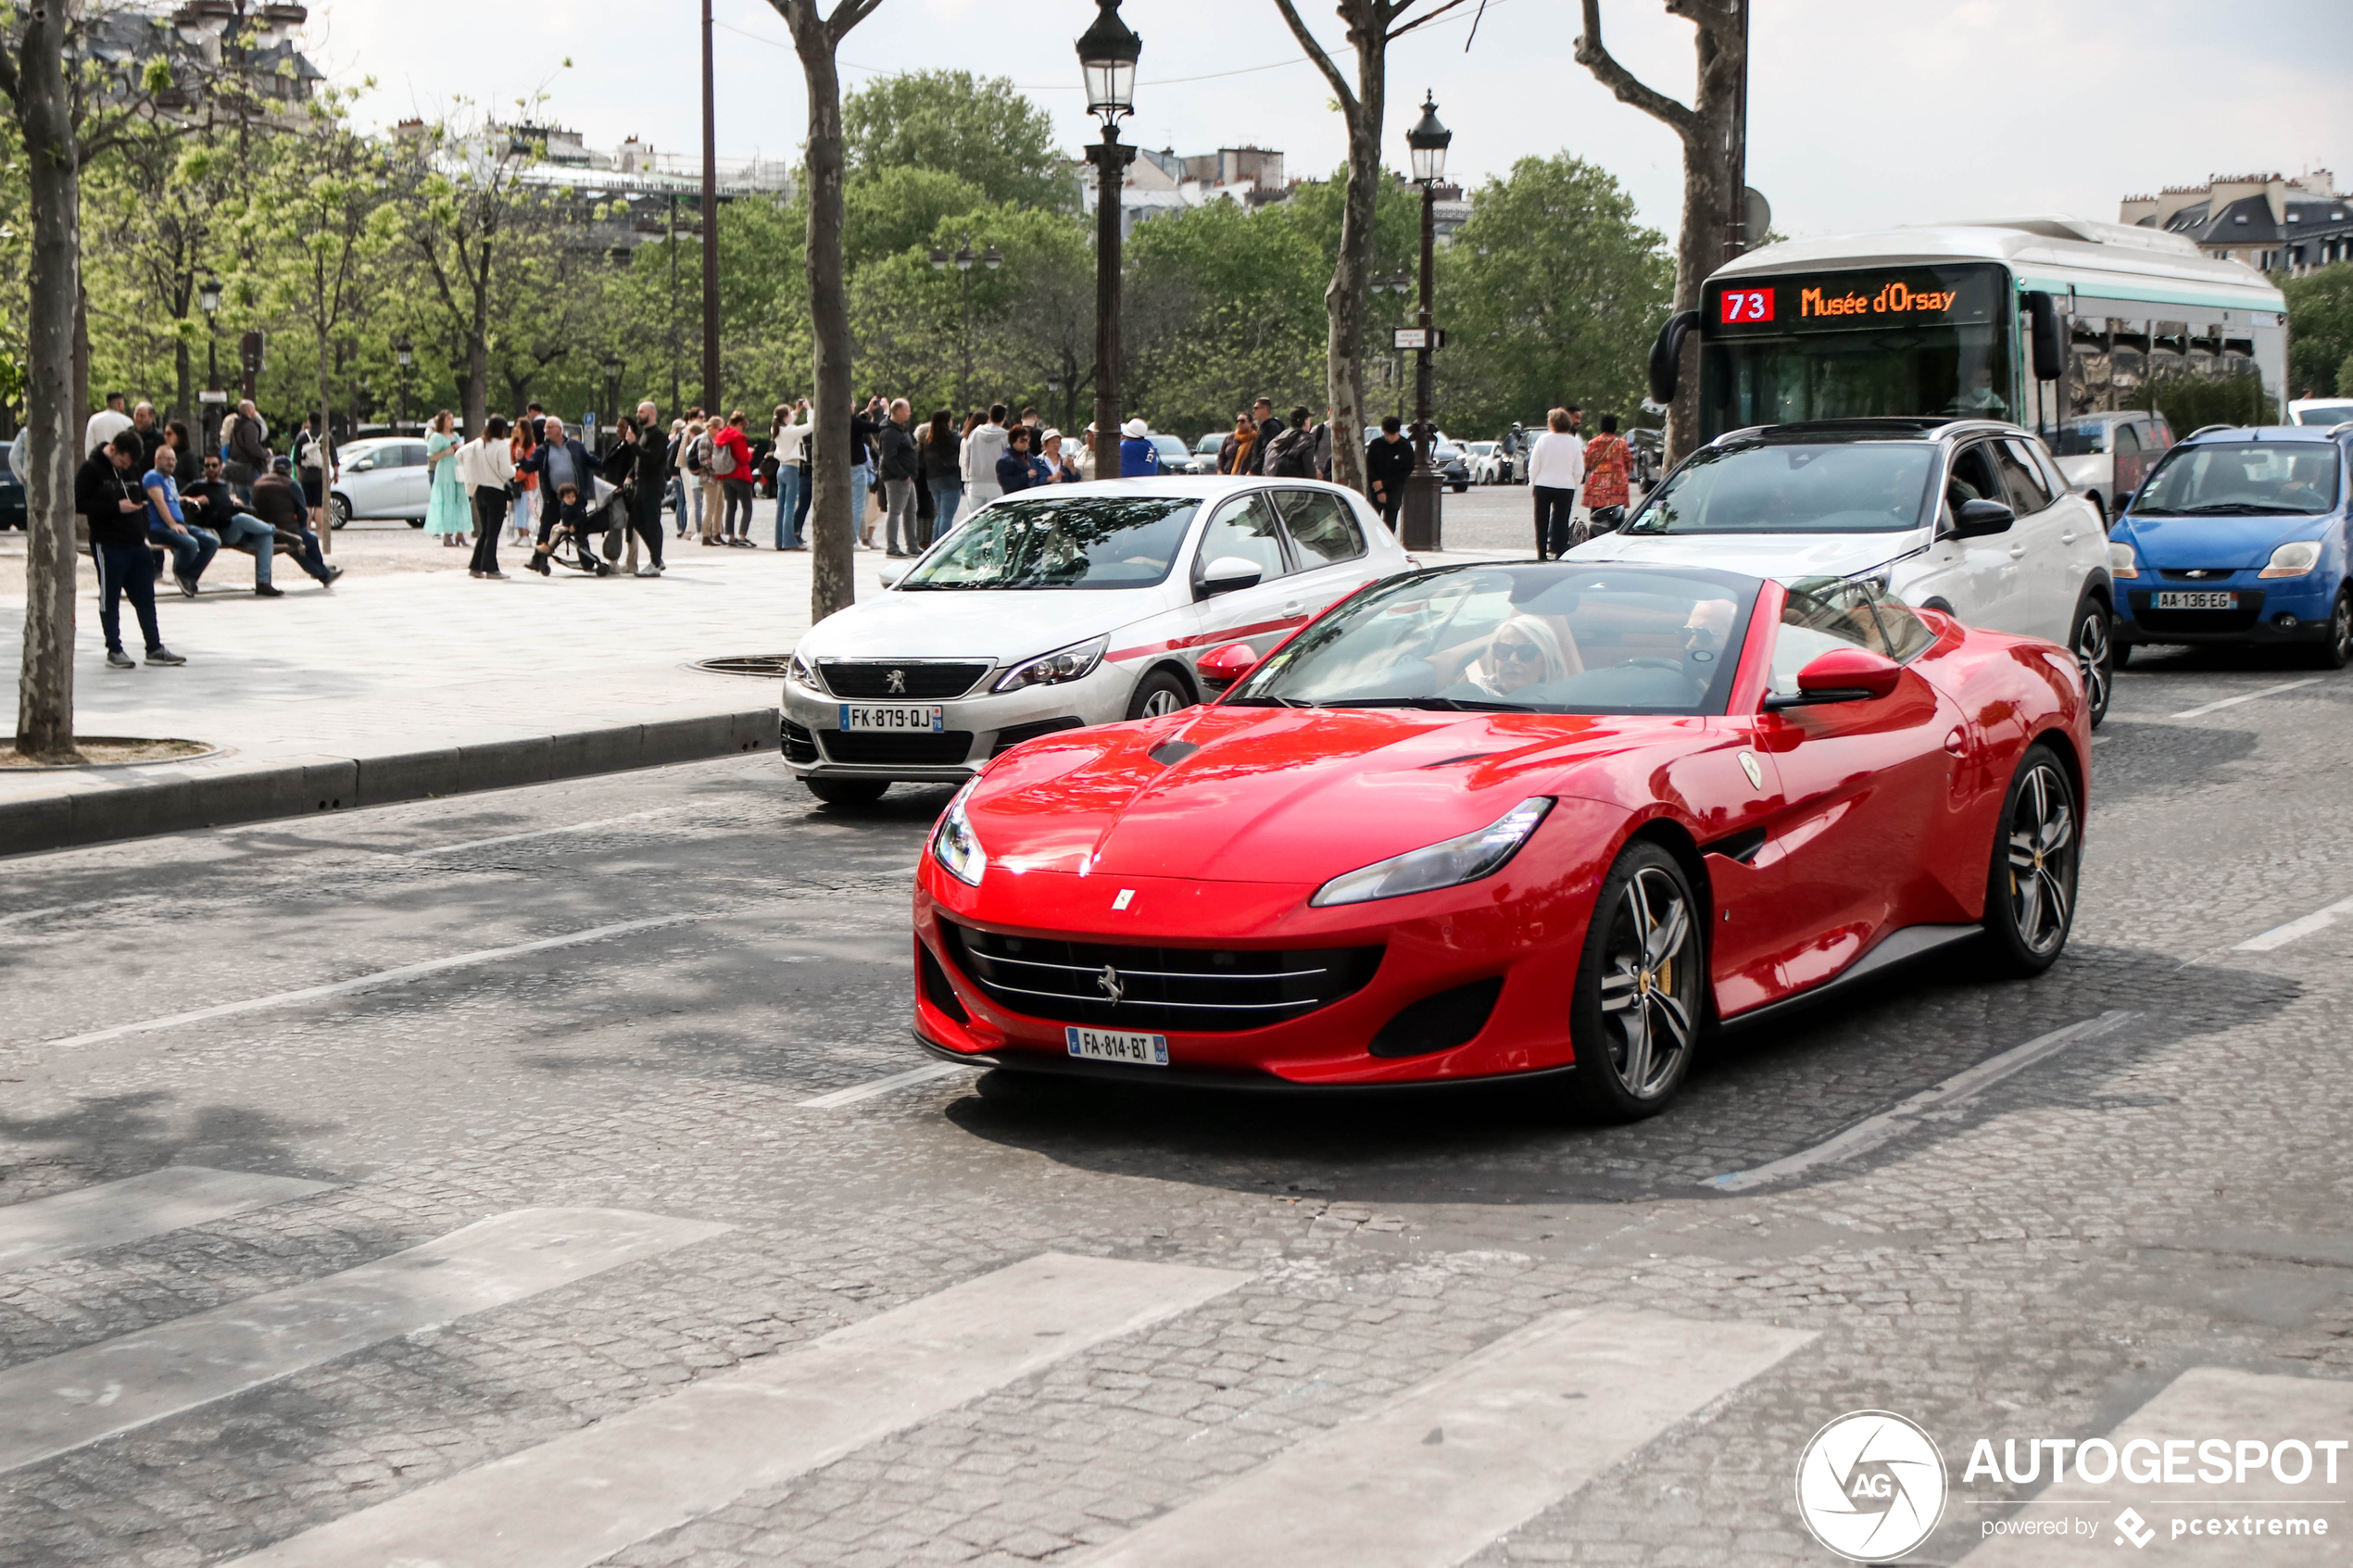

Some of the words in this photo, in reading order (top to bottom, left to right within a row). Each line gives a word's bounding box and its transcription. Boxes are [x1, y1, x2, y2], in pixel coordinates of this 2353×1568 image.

[1727, 292, 1765, 320] 73
[1801, 286, 1869, 317] Musée
[1873, 282, 1957, 313] d'Orsay
[2161, 594, 2227, 608] AA-136-EG
[851, 709, 929, 727] FK-879-QJ
[1083, 1032, 1147, 1060] FA-814-BT
[1156, 1050, 1167, 1061] 06
